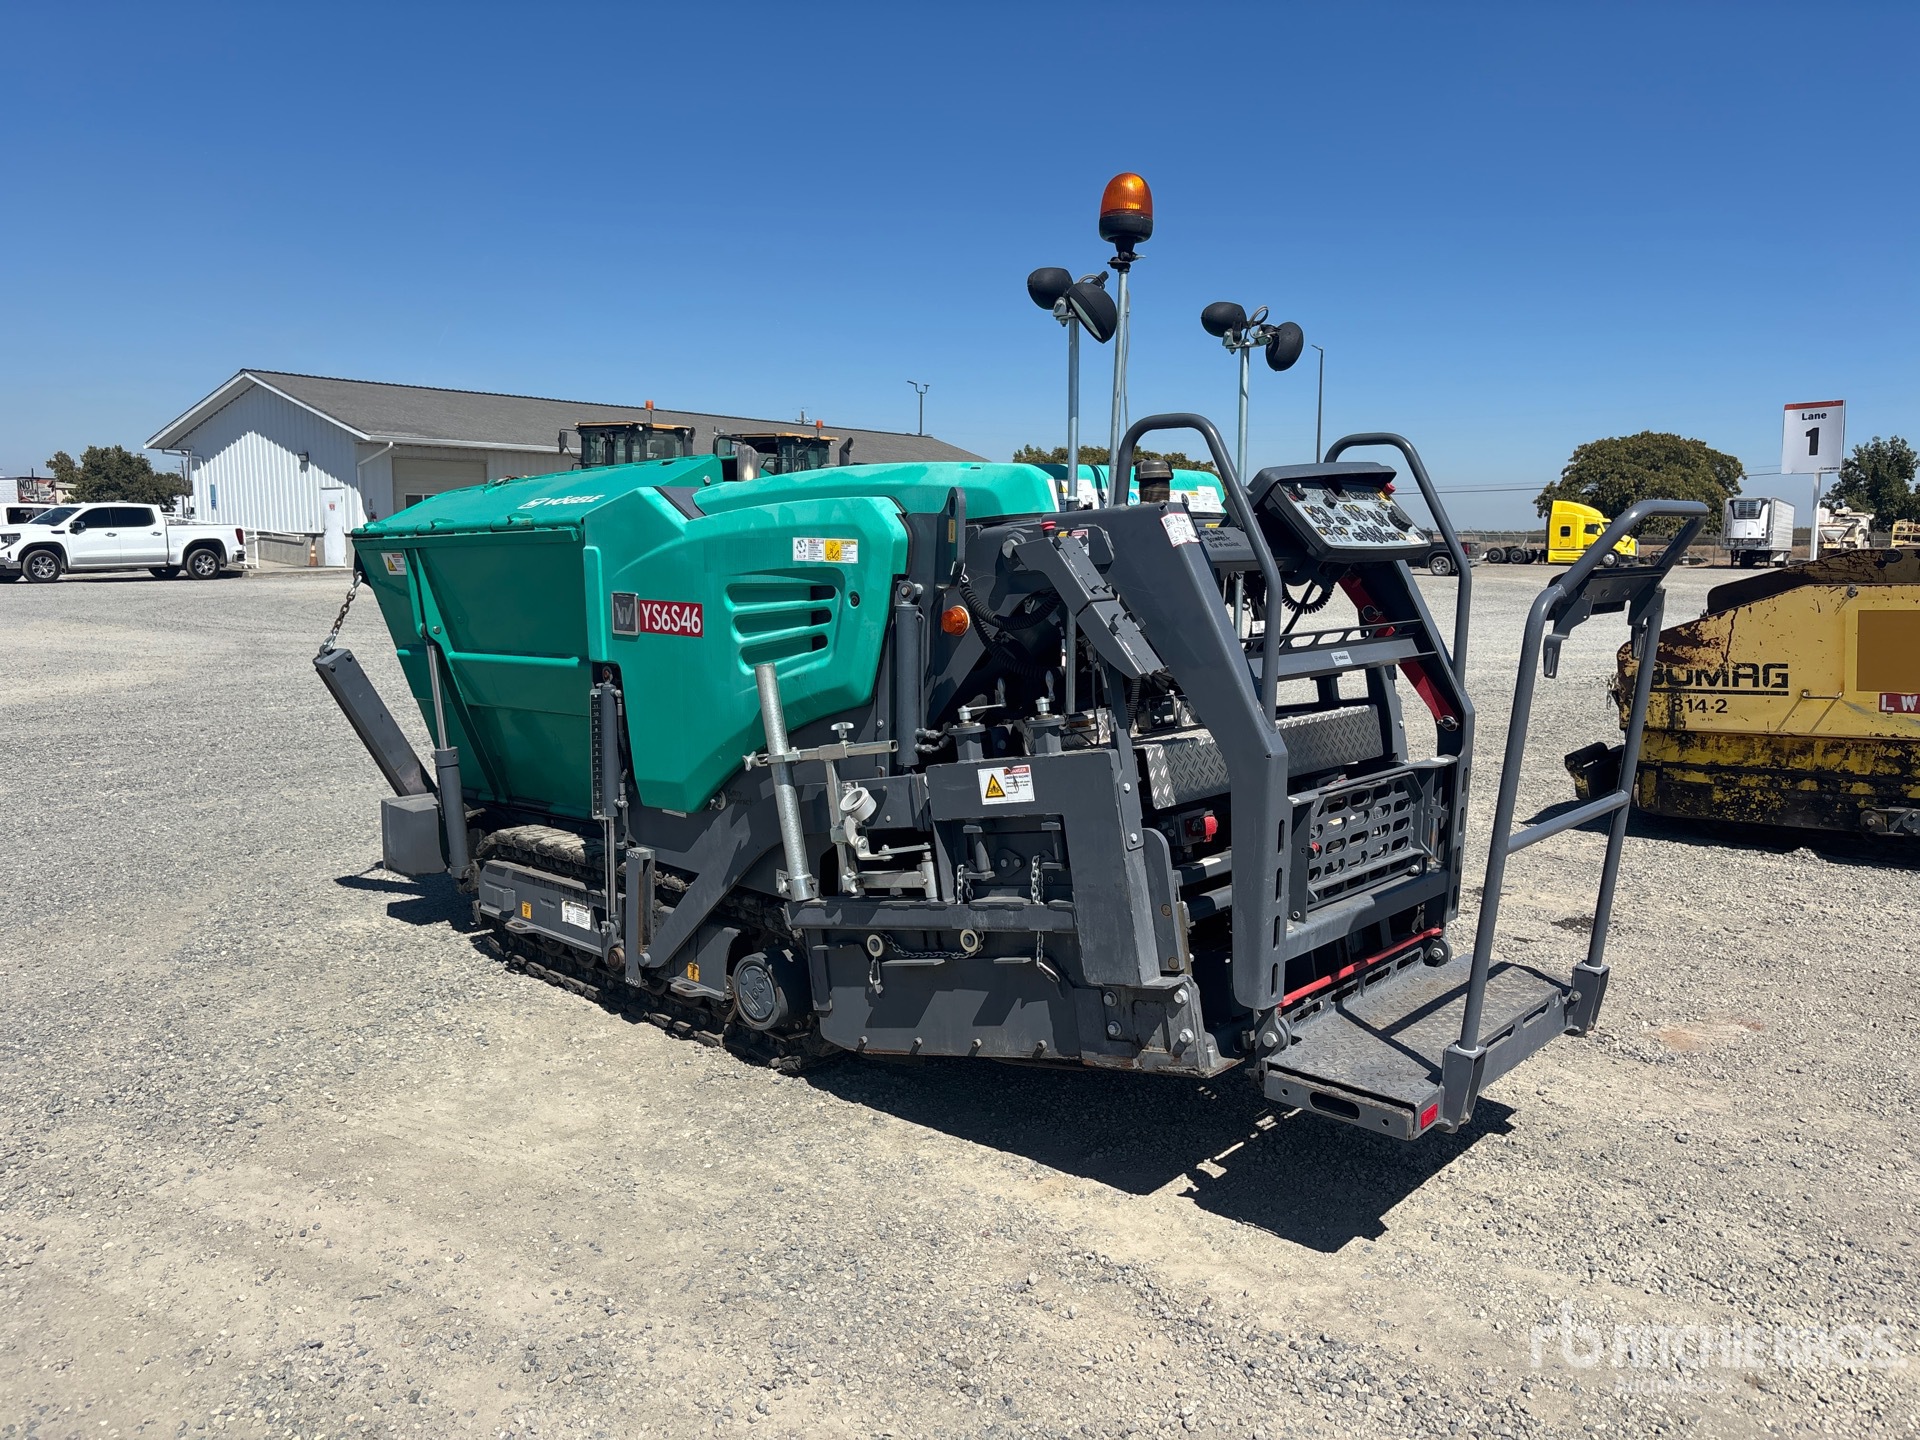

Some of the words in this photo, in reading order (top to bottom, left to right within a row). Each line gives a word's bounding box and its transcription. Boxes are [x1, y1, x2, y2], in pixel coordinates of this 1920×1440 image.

[1801, 412, 1827, 421] Lane
[1805, 427, 1820, 456] 1
[19, 480, 34, 490] NOT
[641, 603, 701, 634] YS6S46
